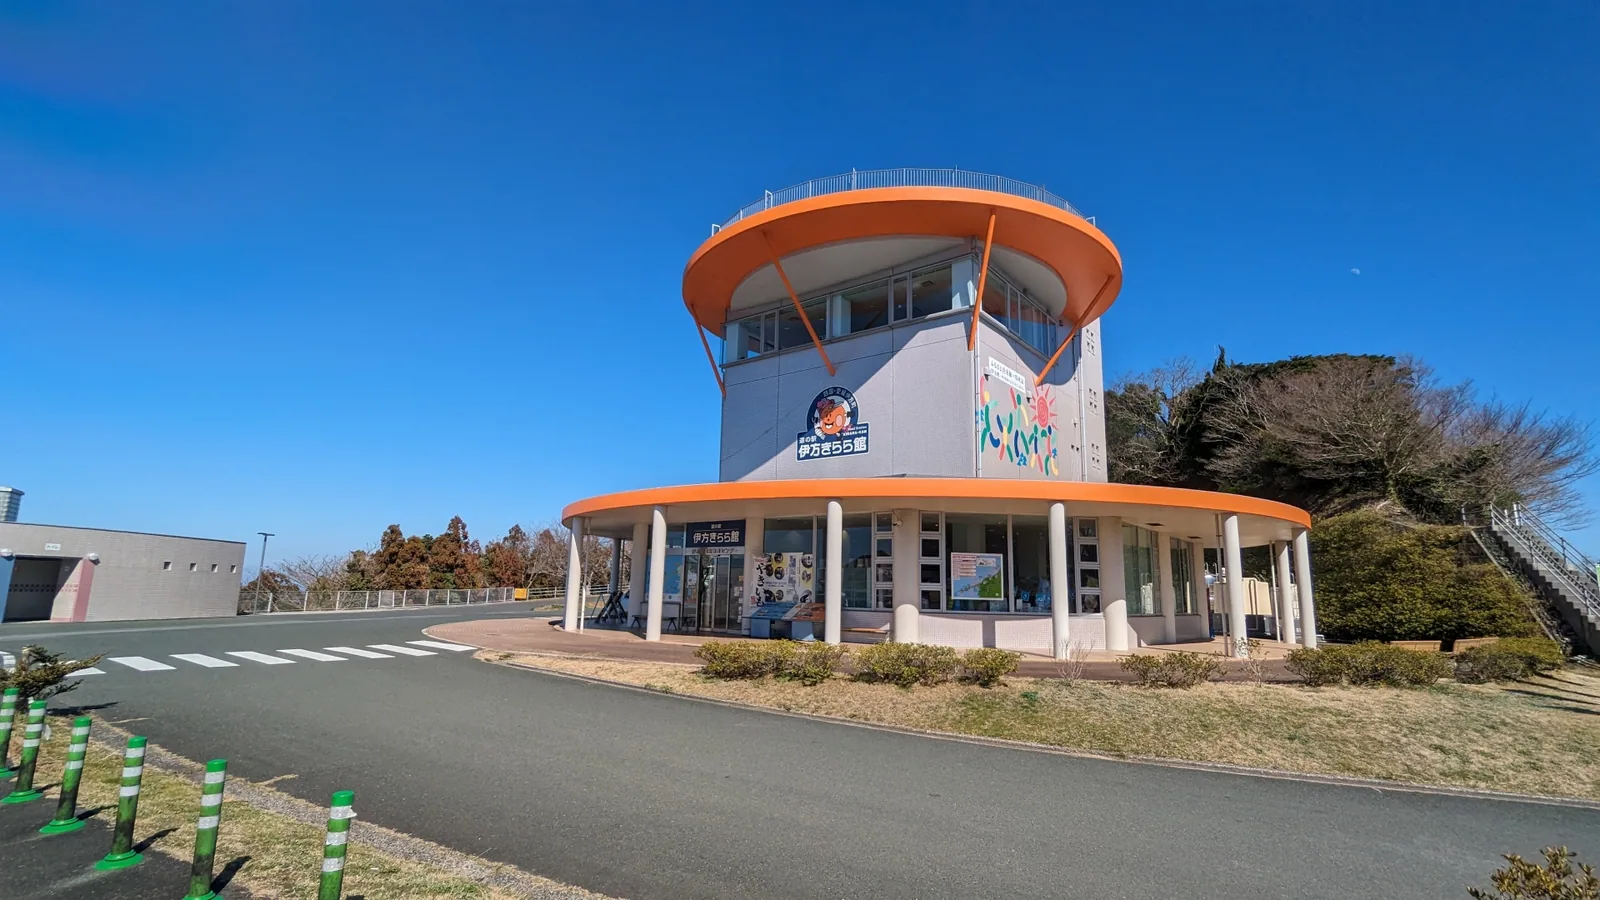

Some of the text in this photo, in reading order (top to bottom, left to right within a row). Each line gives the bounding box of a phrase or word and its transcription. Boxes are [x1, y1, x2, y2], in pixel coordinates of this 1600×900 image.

[798, 437, 867, 458] 伊方きらら館
[799, 436, 817, 444] 道の駅
[693, 530, 740, 544] 伊方きらら館
[756, 562, 766, 607] やきいも
